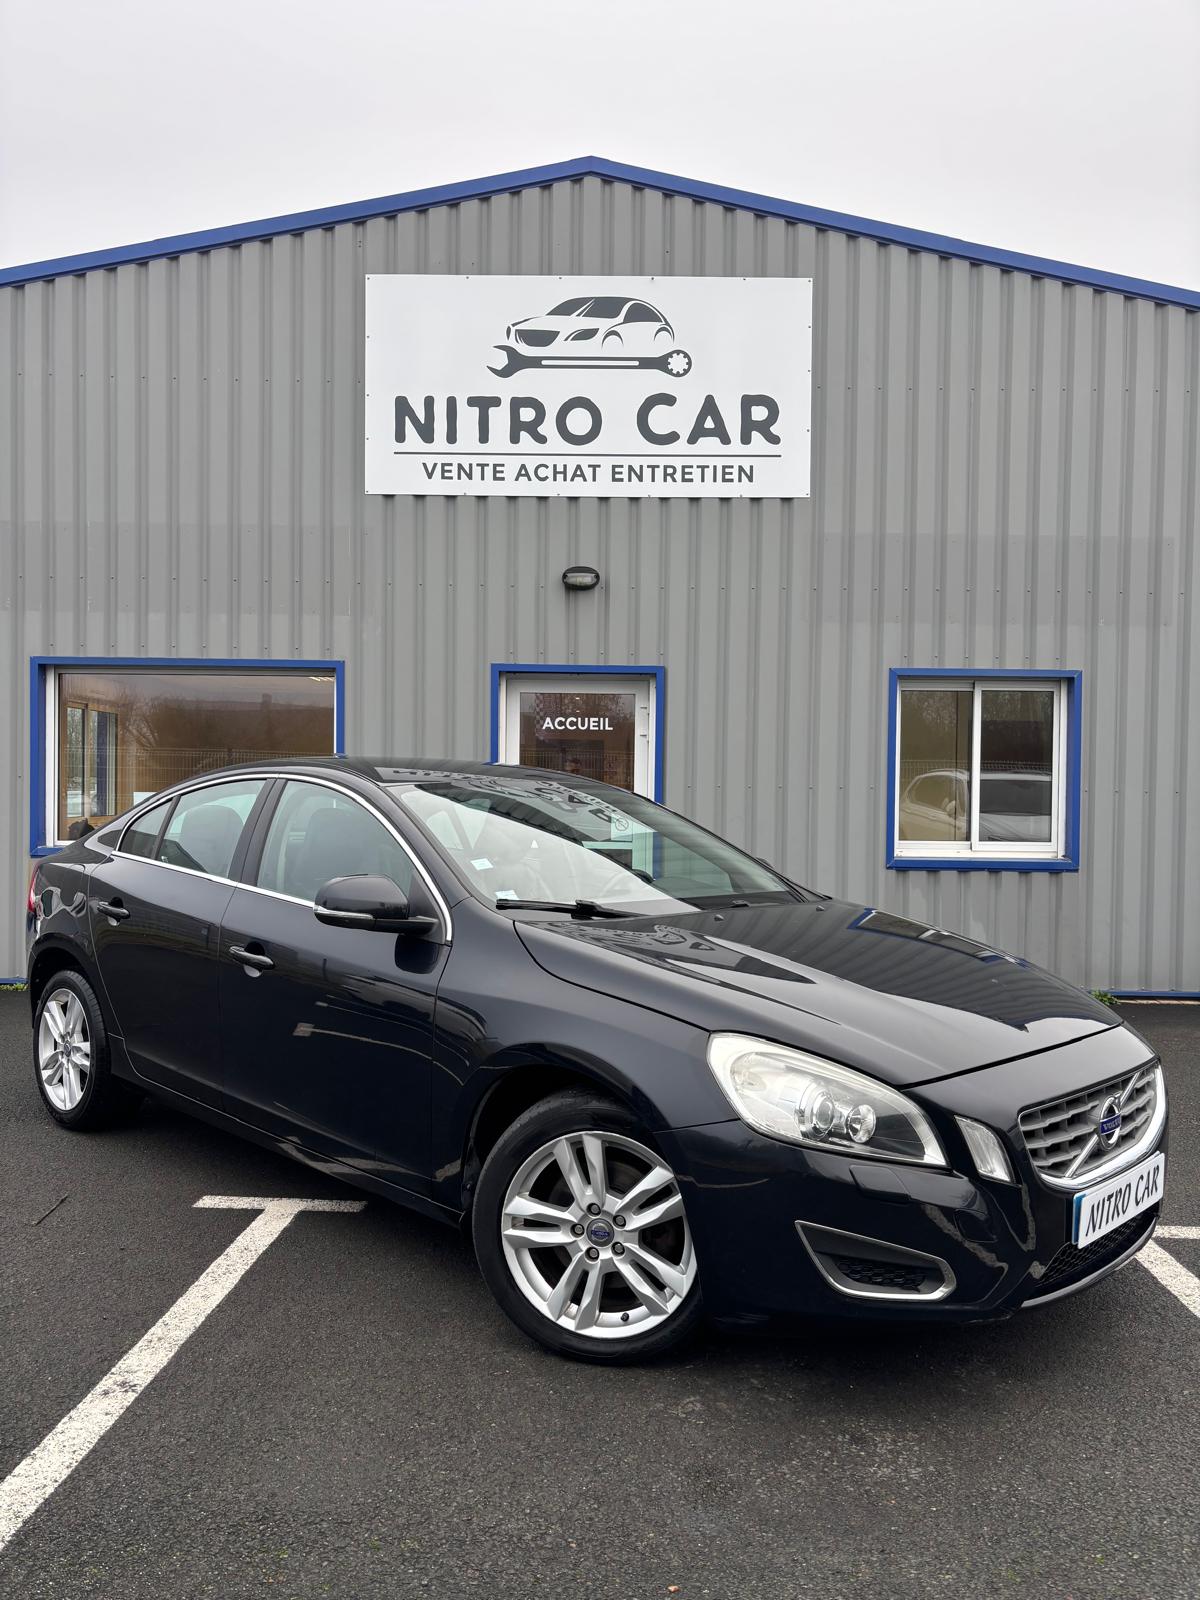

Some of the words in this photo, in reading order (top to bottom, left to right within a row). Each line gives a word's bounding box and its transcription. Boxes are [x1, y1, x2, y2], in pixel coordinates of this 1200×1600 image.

[394, 395, 603, 447] NITRO
[636, 392, 782, 446] CAR
[422, 462, 506, 482] VENTE
[514, 463, 602, 483] ACHAT
[611, 464, 754, 483] ENTRETIEN
[541, 716, 614, 731] ACCUEIL
[1085, 1182, 1132, 1237] NITRO
[1134, 1164, 1160, 1207] CAR
